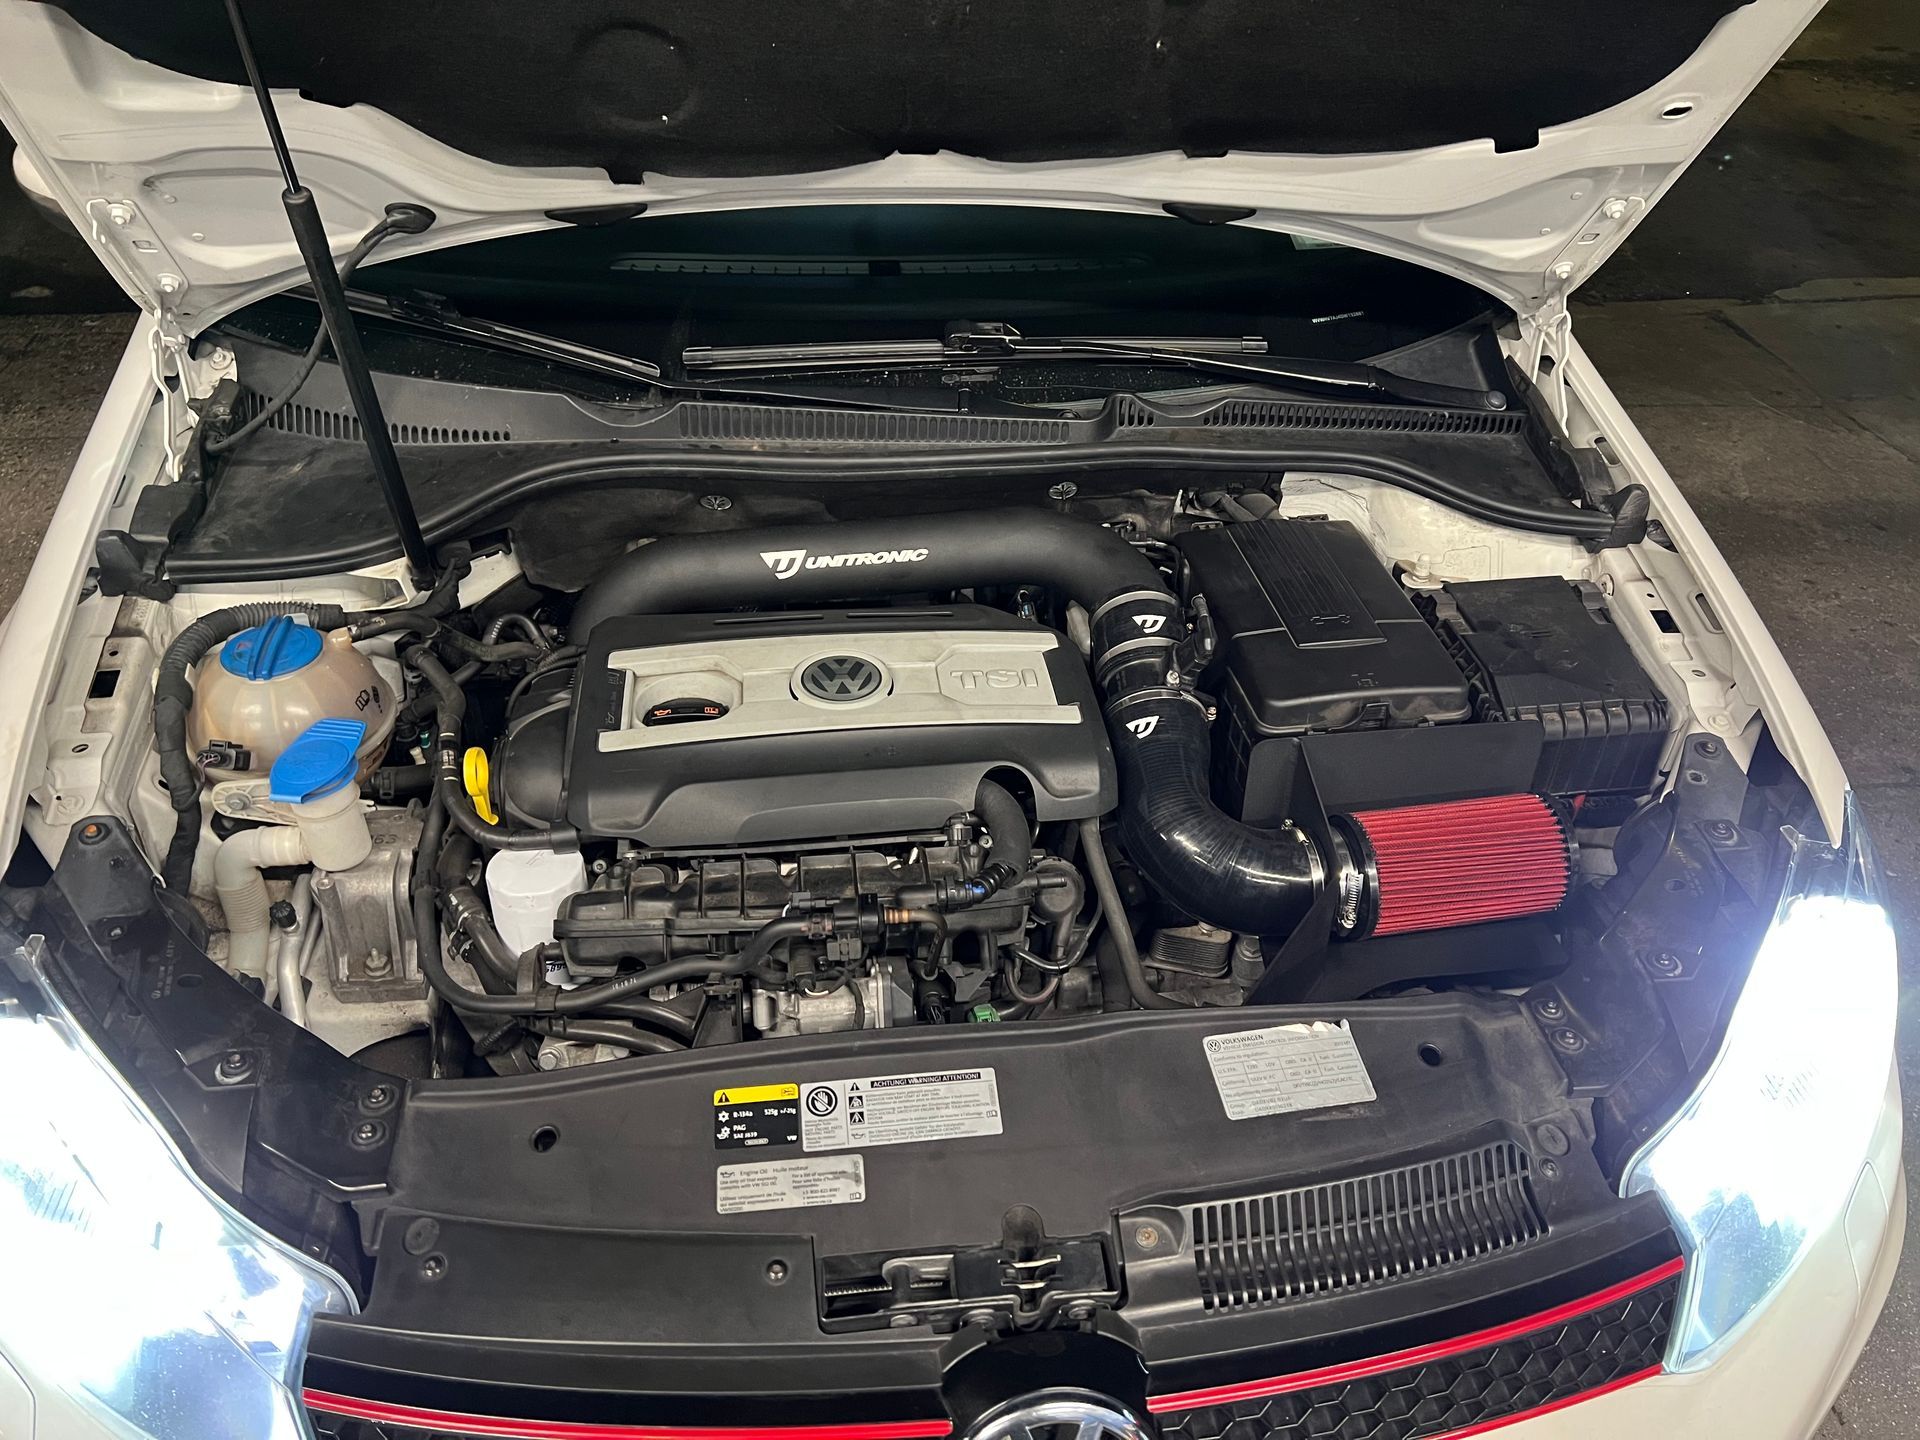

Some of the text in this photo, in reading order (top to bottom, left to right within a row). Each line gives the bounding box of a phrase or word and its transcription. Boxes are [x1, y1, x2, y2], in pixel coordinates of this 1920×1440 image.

[805, 548, 929, 569] UNITRONIC
[950, 668, 1039, 689] TSI
[1220, 1034, 1264, 1046] VOLKSWAGEN
[873, 1073, 979, 1088] ACHTUNG! WARNING! ATTENTION!
[760, 1167, 768, 1175] Oil
